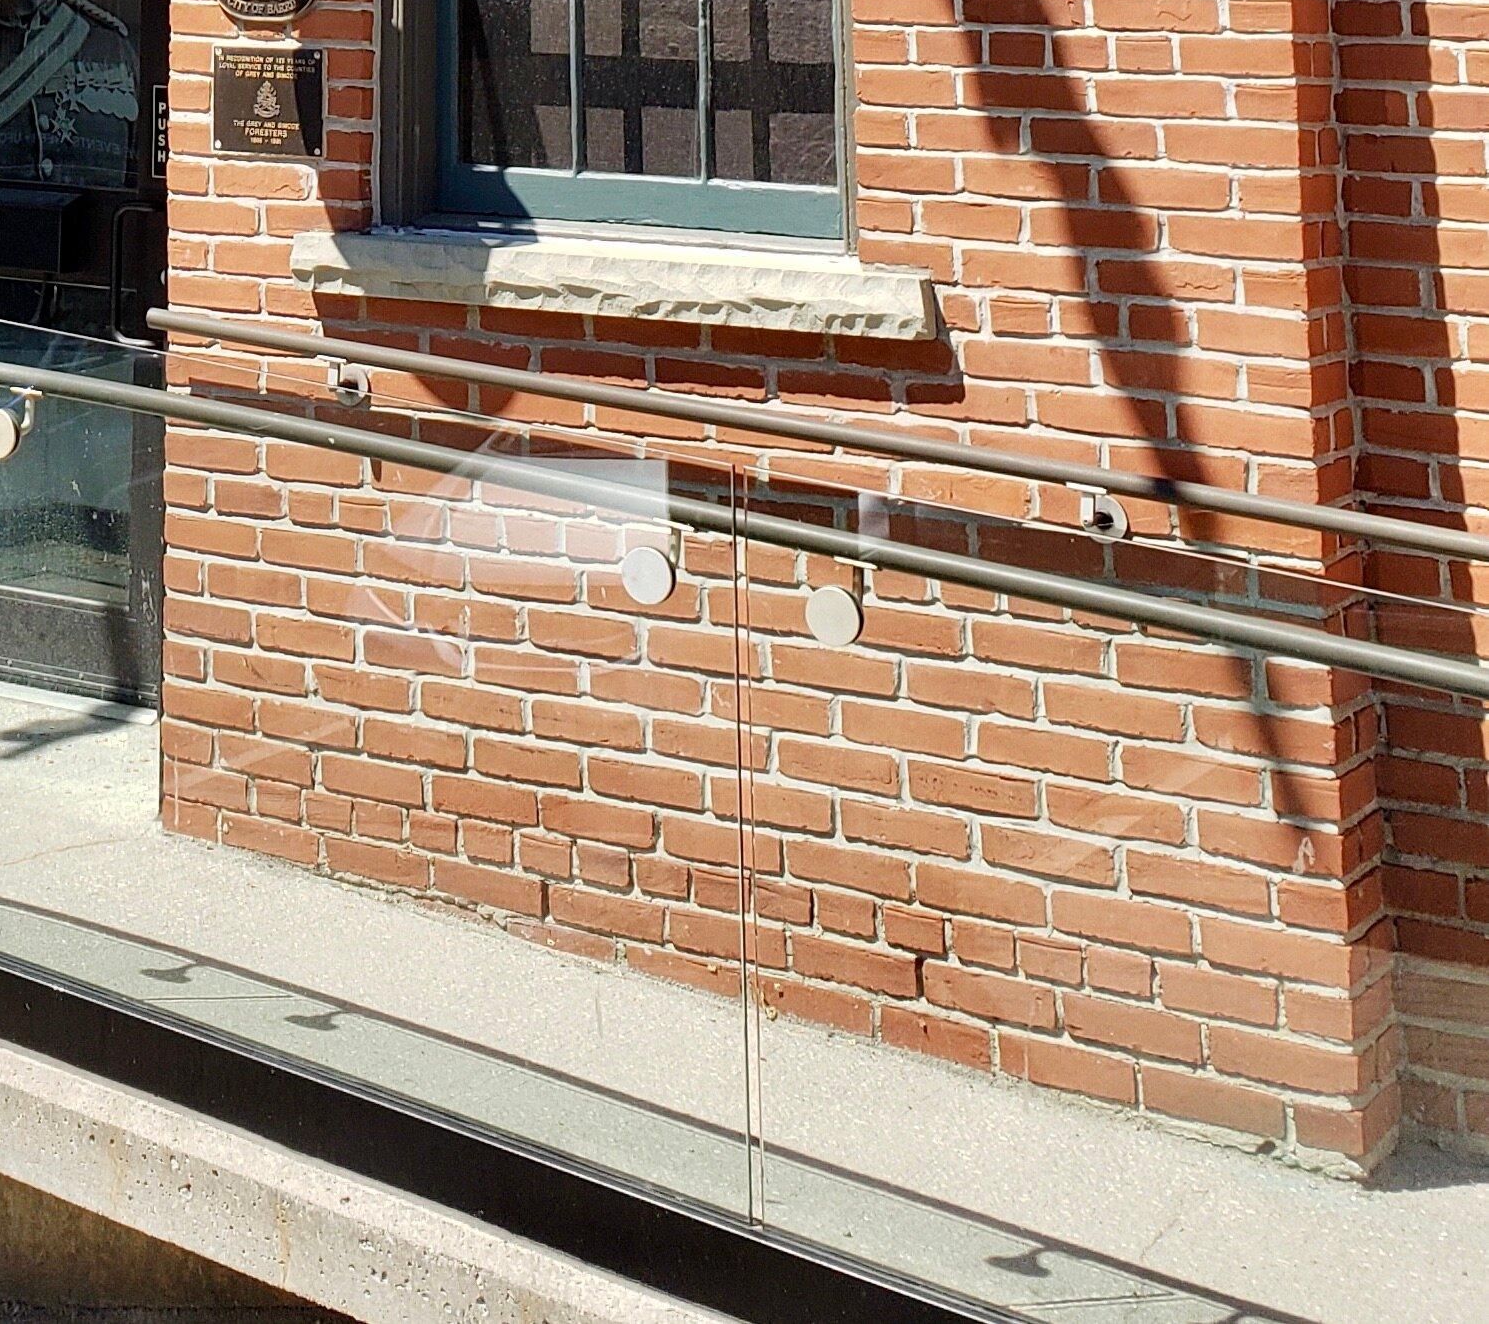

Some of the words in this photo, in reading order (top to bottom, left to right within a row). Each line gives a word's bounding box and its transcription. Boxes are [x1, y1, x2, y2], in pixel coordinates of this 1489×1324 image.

[251, 3, 264, 14] OF
[157, 102, 167, 163] PUSH
[244, 127, 288, 138] FORESTERS
